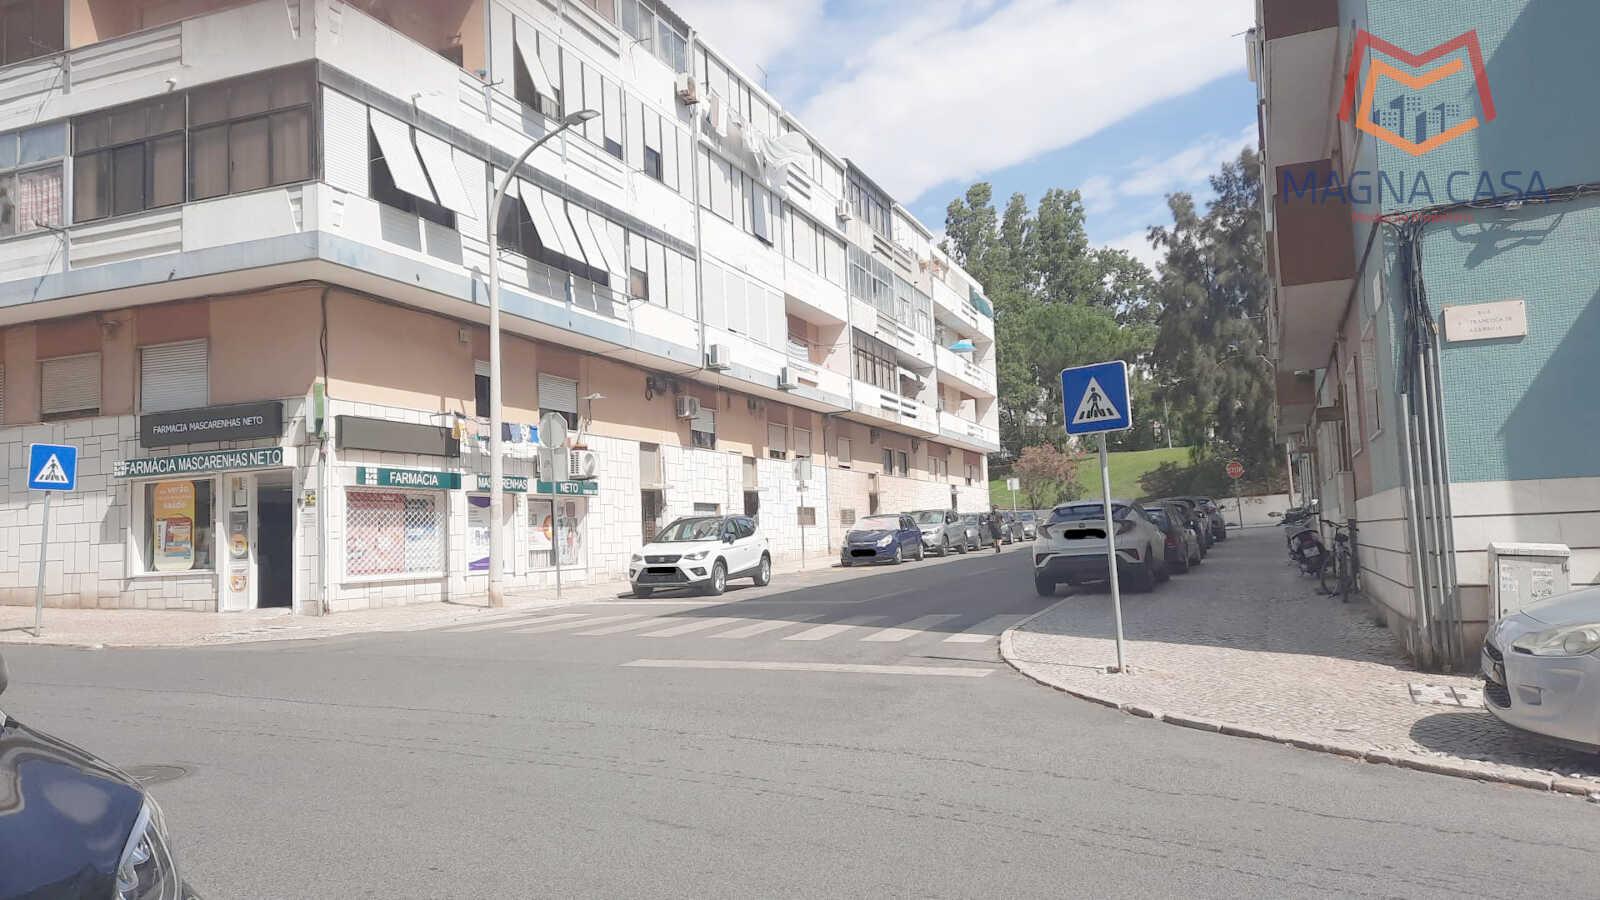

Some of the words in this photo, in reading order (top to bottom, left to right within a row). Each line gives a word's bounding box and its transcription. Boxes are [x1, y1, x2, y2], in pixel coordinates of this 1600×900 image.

[152, 423, 188, 435] FARMACIA
[189, 417, 241, 431] MASCARENHAS
[242, 415, 264, 425] NETO
[124, 457, 176, 475] FARMÁCIA
[178, 452, 248, 472] MASCARENHAS
[249, 449, 282, 466] NETO
[389, 471, 439, 486] FARMÁCIA
[560, 482, 579, 494] NETO
